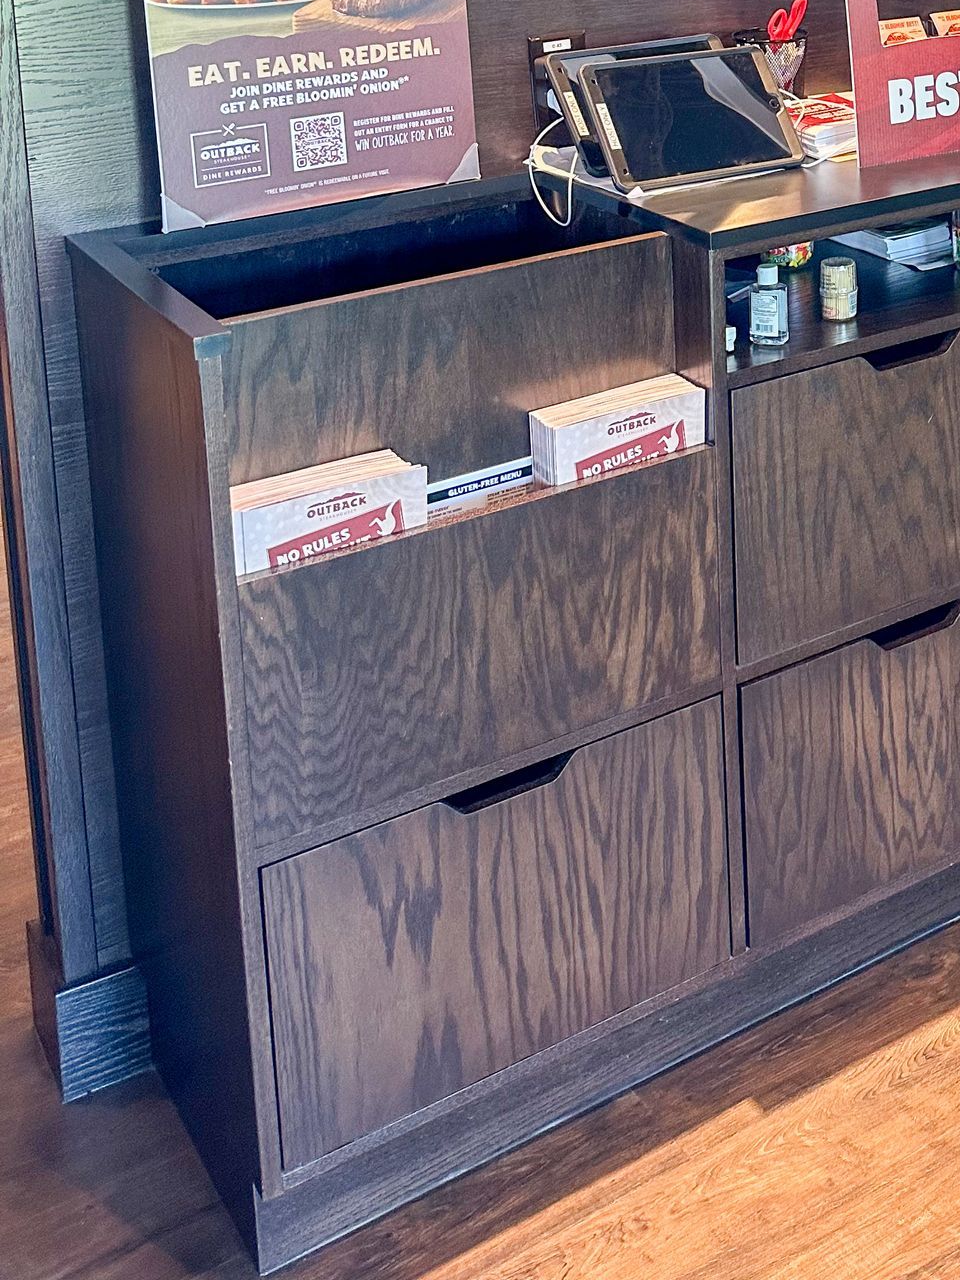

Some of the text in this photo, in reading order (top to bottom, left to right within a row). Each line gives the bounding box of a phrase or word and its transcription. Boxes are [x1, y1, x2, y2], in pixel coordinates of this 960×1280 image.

[187, 36, 440, 88] EAT. EARN. REDEEM.
[229, 68, 389, 99] JOIN DINE REWARDS AND
[220, 101, 246, 115] GET
[249, 99, 260, 111] A
[263, 95, 294, 109] FREE
[297, 86, 356, 104] BLOOMIN'
[353, 116, 380, 127] REGISTER
[405, 109, 431, 119] REWARDS
[431, 107, 442, 115] AND
[375, 125, 392, 133] ENTRY
[393, 123, 408, 131] FORM
[425, 117, 445, 126] CHANCE
[372, 131, 408, 149] OUTBACK
[411, 129, 425, 143] FOR
[427, 128, 434, 140] A
[435, 125, 455, 139] YEAR.
[200, 143, 260, 161] OUTBACK
[203, 166, 262, 181] DINE REWARDS
[608, 416, 656, 436] OUTBACK
[582, 463, 602, 478] NO
[602, 445, 643, 471] RULES
[447, 469, 522, 497] GLUTEN-FREE MENU
[306, 495, 367, 519] OUTBACK
[276, 548, 300, 566] NO
[302, 528, 350, 556] RULES
